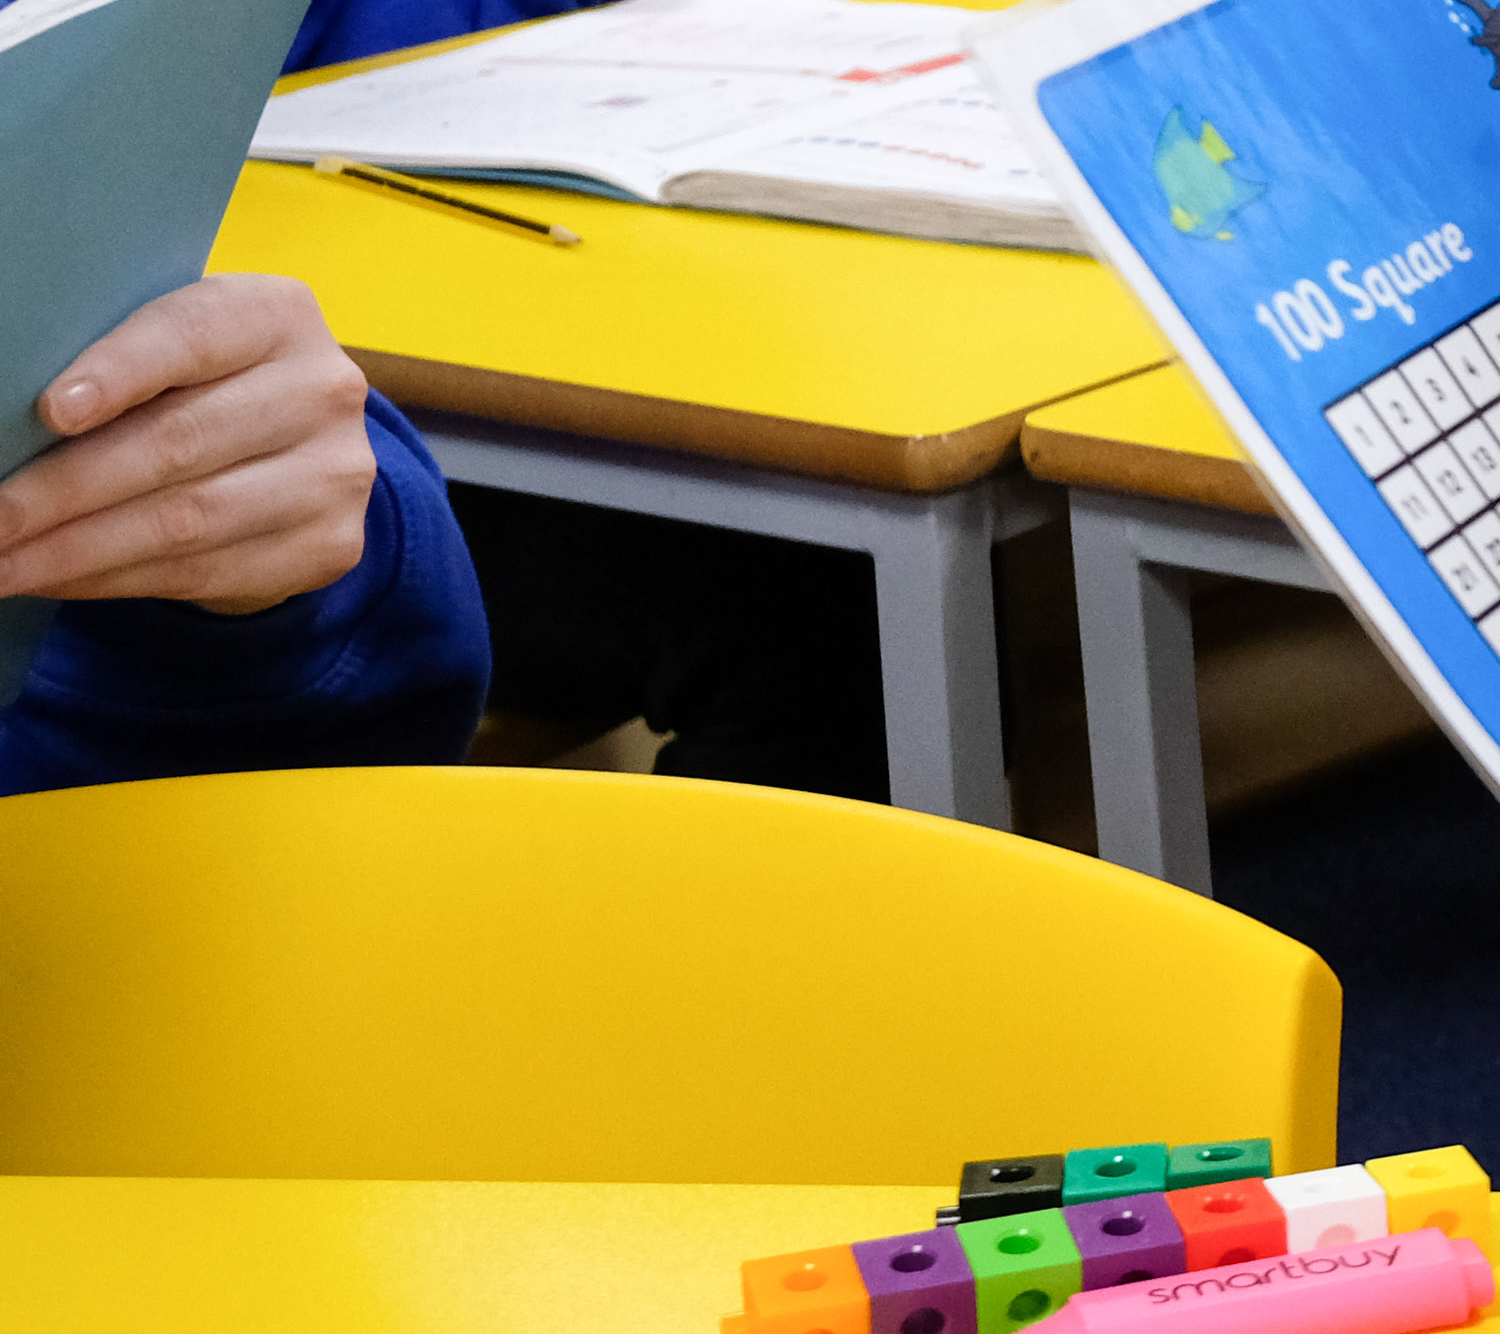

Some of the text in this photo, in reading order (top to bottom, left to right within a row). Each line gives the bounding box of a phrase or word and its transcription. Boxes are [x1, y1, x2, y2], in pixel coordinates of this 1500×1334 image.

[1255, 222, 1474, 361] 100 Square
[1390, 401, 1411, 424] 2
[1426, 379, 1445, 402] 3
[1148, 1244, 1401, 1305] smartbuy
